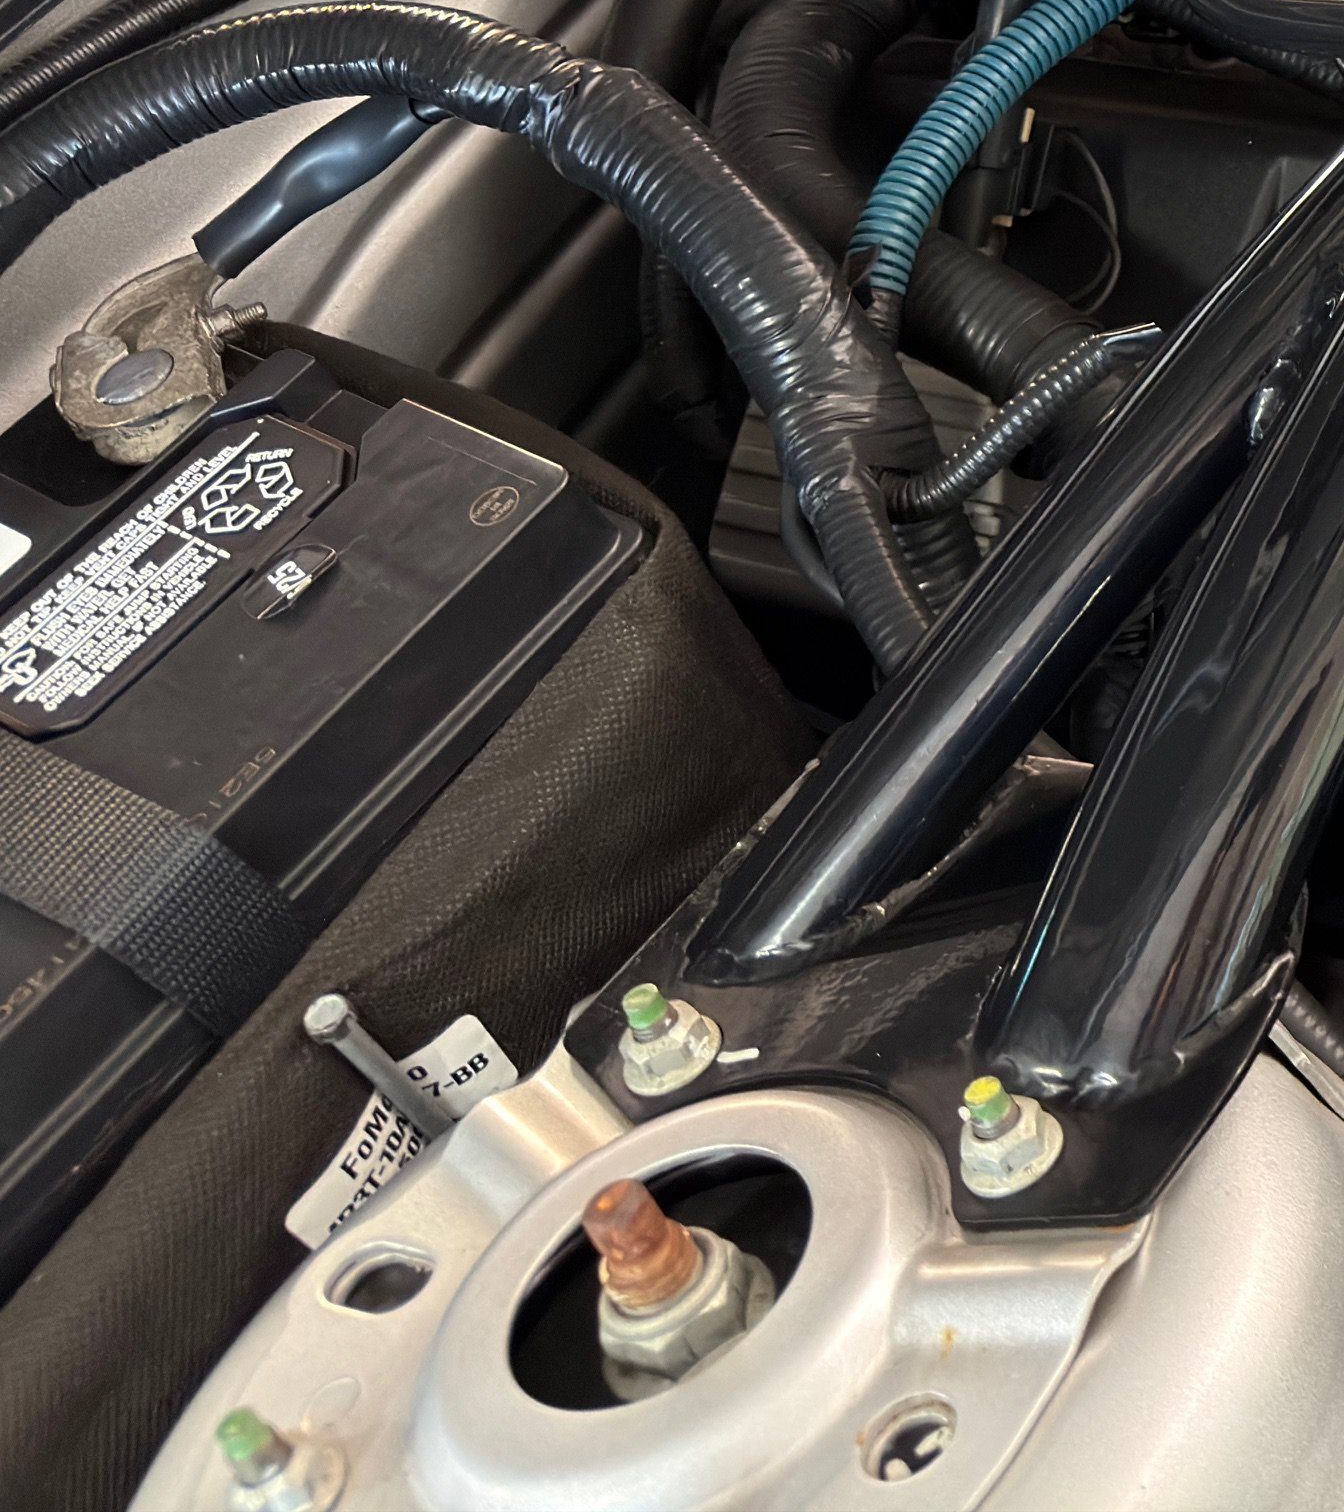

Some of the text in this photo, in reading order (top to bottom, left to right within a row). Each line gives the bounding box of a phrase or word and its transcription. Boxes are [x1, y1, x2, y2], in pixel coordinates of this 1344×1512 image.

[0, 610, 34, 640] KEEP
[30, 588, 59, 616] OUT
[97, 518, 140, 554] REACH
[153, 457, 210, 508] CHILDREN
[53, 575, 87, 604] KEEP
[177, 472, 205, 494] AND
[36, 553, 207, 703] FOLLOW INSTRUCTIONS IN VEHICLE
[39, 623, 76, 651] WITH
[107, 565, 137, 589] GET
[49, 560, 159, 657] MEDICAL HELP FAST
[65, 586, 100, 614] EYES
[72, 638, 99, 659] FOR
[94, 614, 125, 638] SAFE
[120, 589, 153, 616] JUMP
[146, 547, 199, 593] STARTING
[142, 600, 167, 621] NOT
